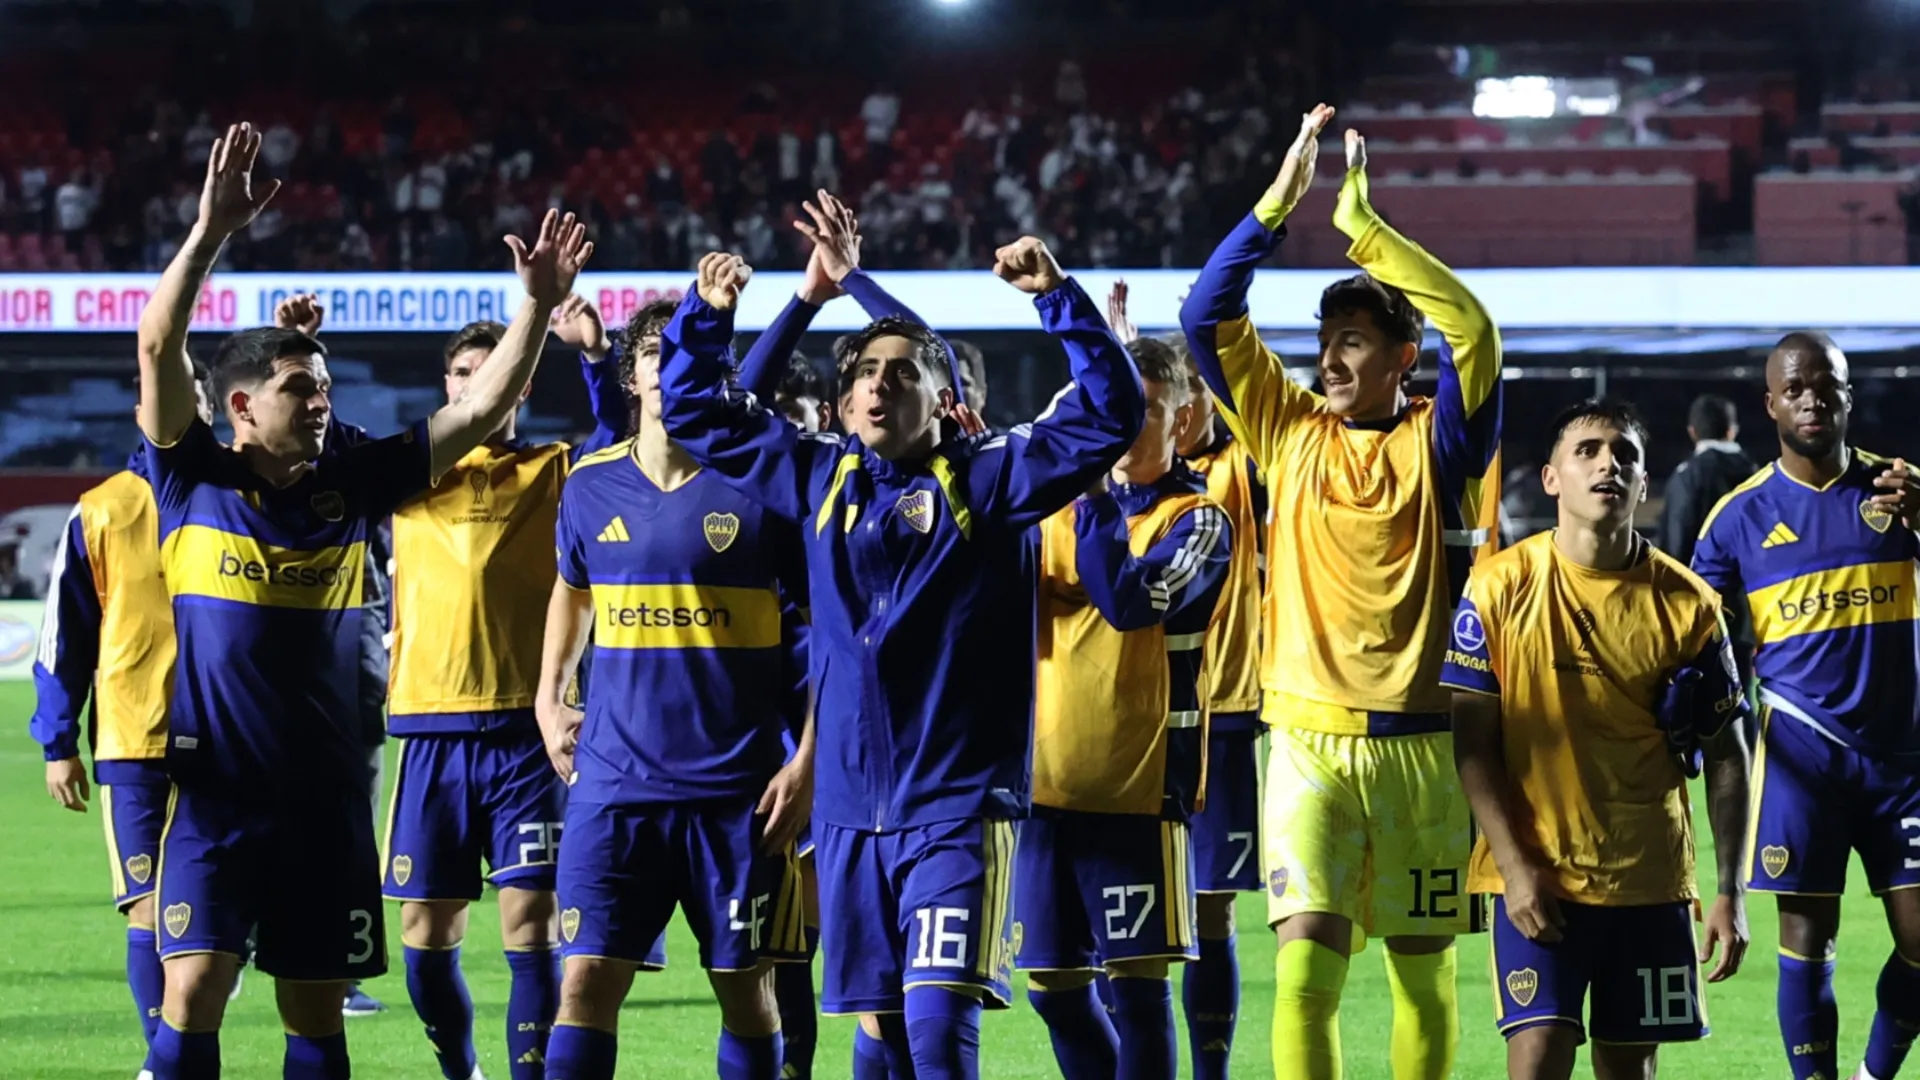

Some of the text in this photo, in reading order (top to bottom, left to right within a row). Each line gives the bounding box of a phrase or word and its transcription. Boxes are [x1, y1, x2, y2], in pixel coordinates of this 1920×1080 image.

[75, 277, 237, 322] CAMÃO
[600, 288, 683, 321] BR
[219, 549, 350, 587] betsson
[607, 602, 730, 627] betsson
[1228, 832, 1253, 879] 7
[1103, 884, 1155, 940] 27
[1408, 868, 1458, 918] 12
[347, 909, 374, 964] 3
[912, 908, 969, 968] 16
[1637, 966, 1694, 1026] 18
